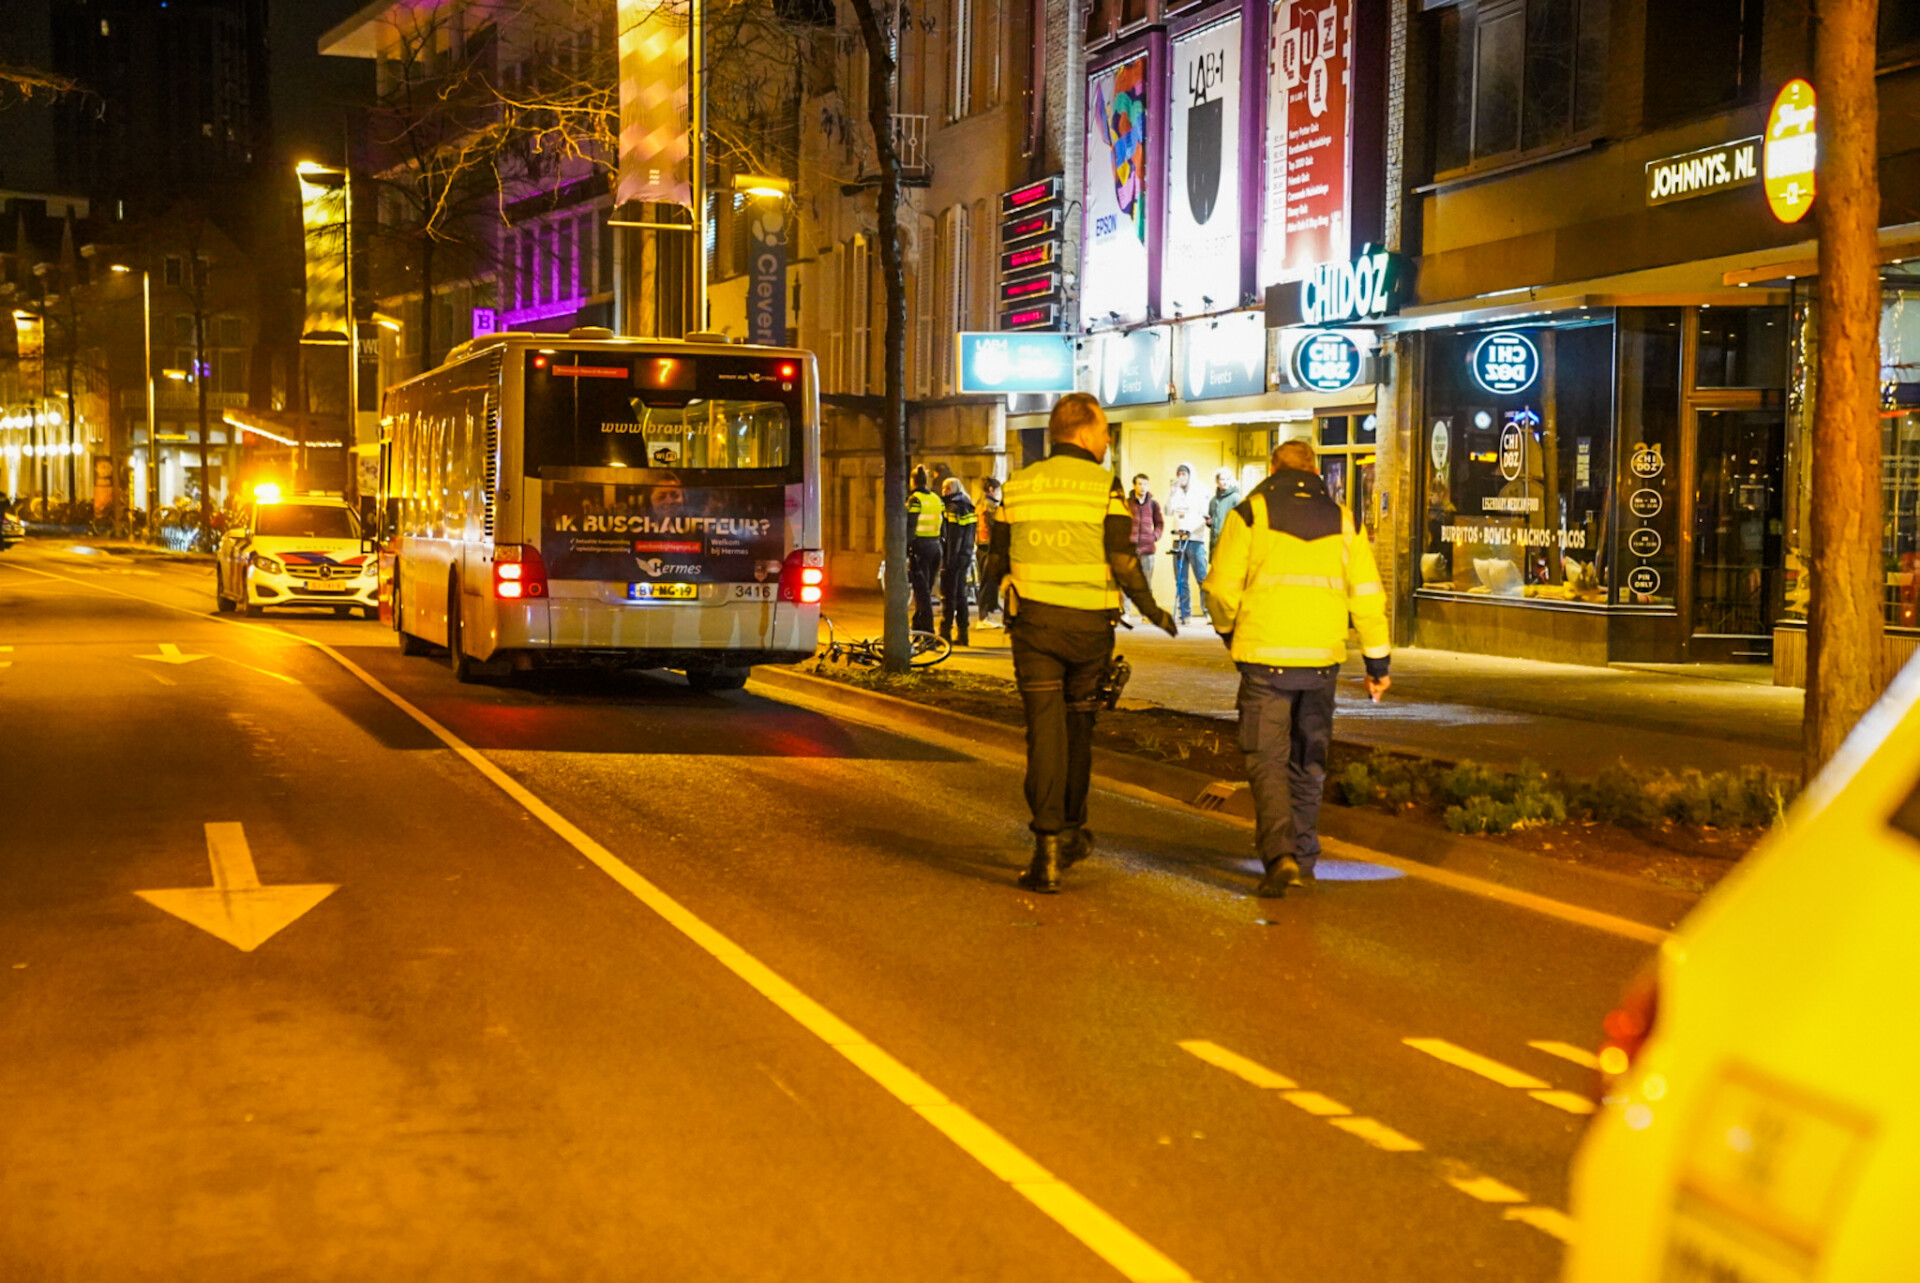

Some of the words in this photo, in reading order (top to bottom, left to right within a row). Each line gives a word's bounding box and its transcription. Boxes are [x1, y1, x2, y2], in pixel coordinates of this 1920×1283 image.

[1095, 213, 1118, 237] EPSON
[1309, 341, 1347, 362] CHI
[659, 359, 671, 384] 7
[1209, 370, 1233, 386] Events
[1503, 434, 1519, 449] CHI
[1636, 454, 1657, 463] CHI
[583, 515, 771, 535] BUSCHAUFFEUR?
[711, 538, 740, 546] Welkom
[1028, 529, 1071, 547] OvD
[1441, 525, 1478, 543] BURRITOS
[1484, 526, 1510, 545] BOWLS
[1516, 528, 1551, 547] NACHOS
[1557, 529, 1586, 548] TACOS
[711, 547, 721, 555] bij
[653, 558, 702, 575] Hermes
[735, 585, 771, 597] 3416
